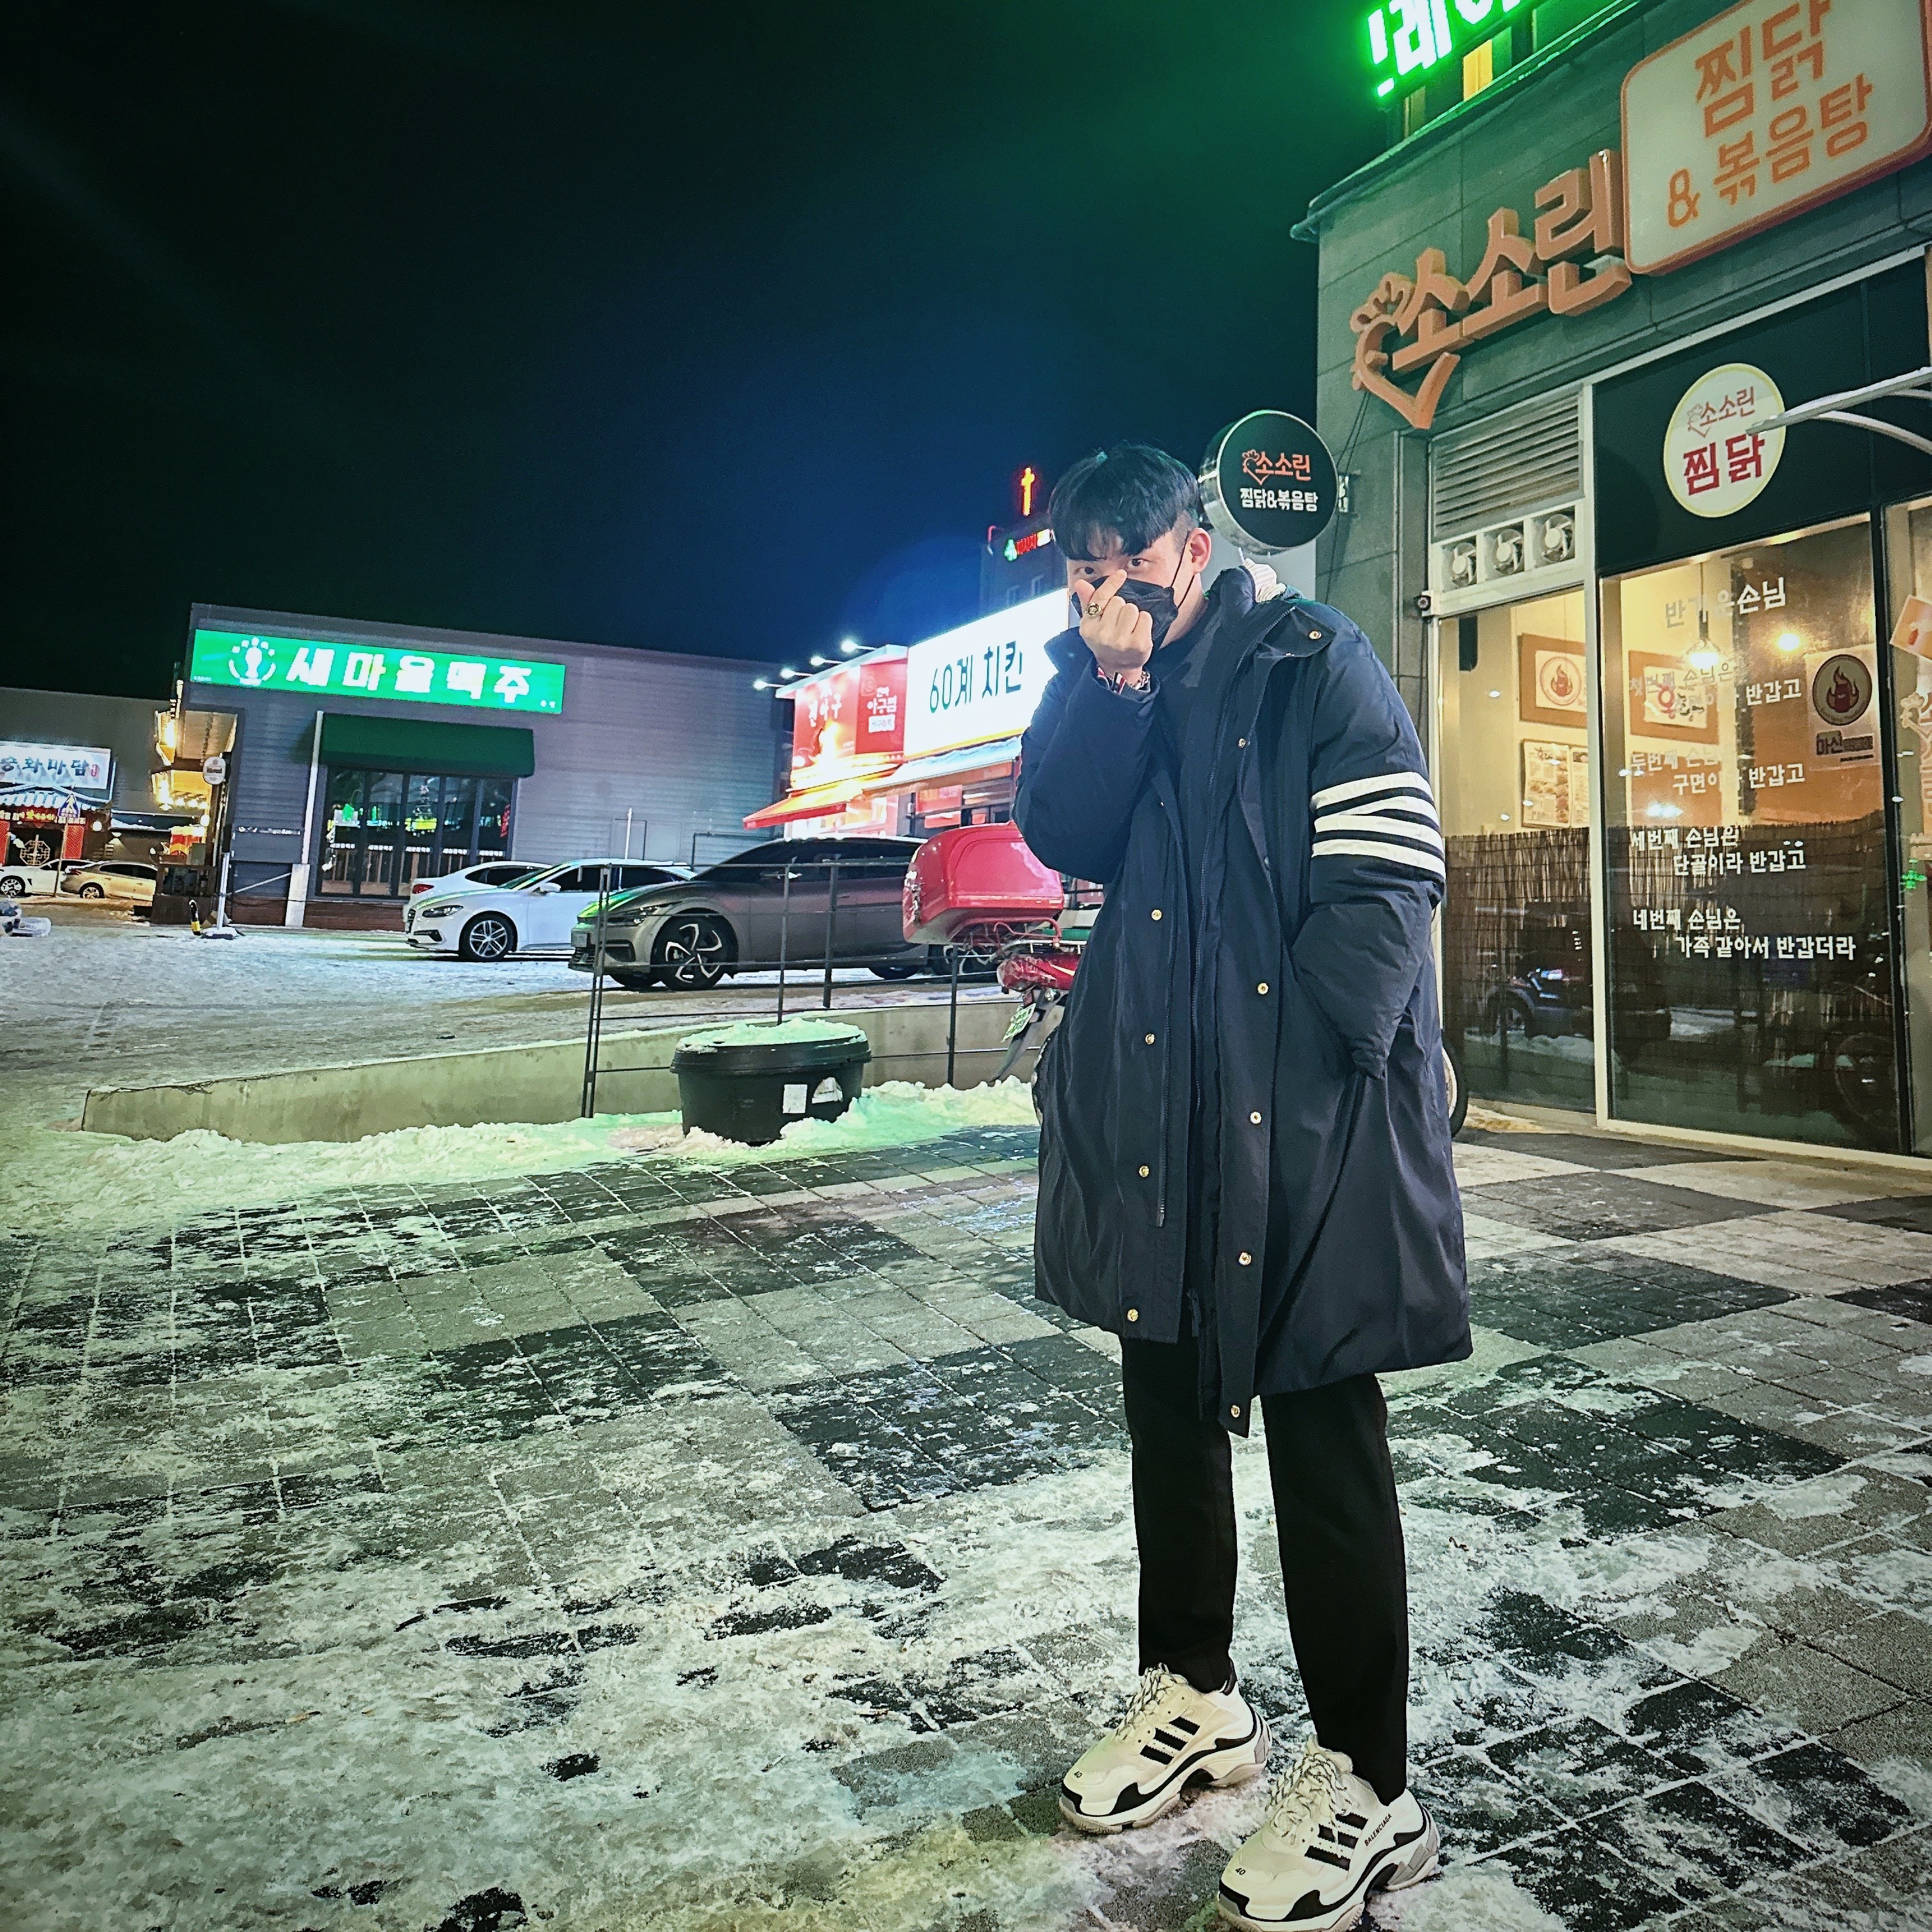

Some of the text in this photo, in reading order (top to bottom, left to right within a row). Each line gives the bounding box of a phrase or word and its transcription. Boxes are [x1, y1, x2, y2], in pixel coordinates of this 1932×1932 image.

[1695, 0, 1830, 138] 찜닭
[1713, 72, 1873, 206] 볶음탕
[1393, 148, 1632, 372] 소소린
[1699, 386, 1756, 427] 소소린
[1255, 450, 1312, 481] 소소린
[1683, 433, 1765, 496] 찜닭
[1745, 678, 1802, 706] 반갑고
[1748, 763, 1805, 789] 반갑고
[1673, 850, 1806, 876] 단골이라 반갑고
[1633, 908, 1741, 930] 네번째 손님은
[1776, 935, 1856, 960] 반갑더라
[1364, 1813, 1392, 1847] BALENCIAGA
